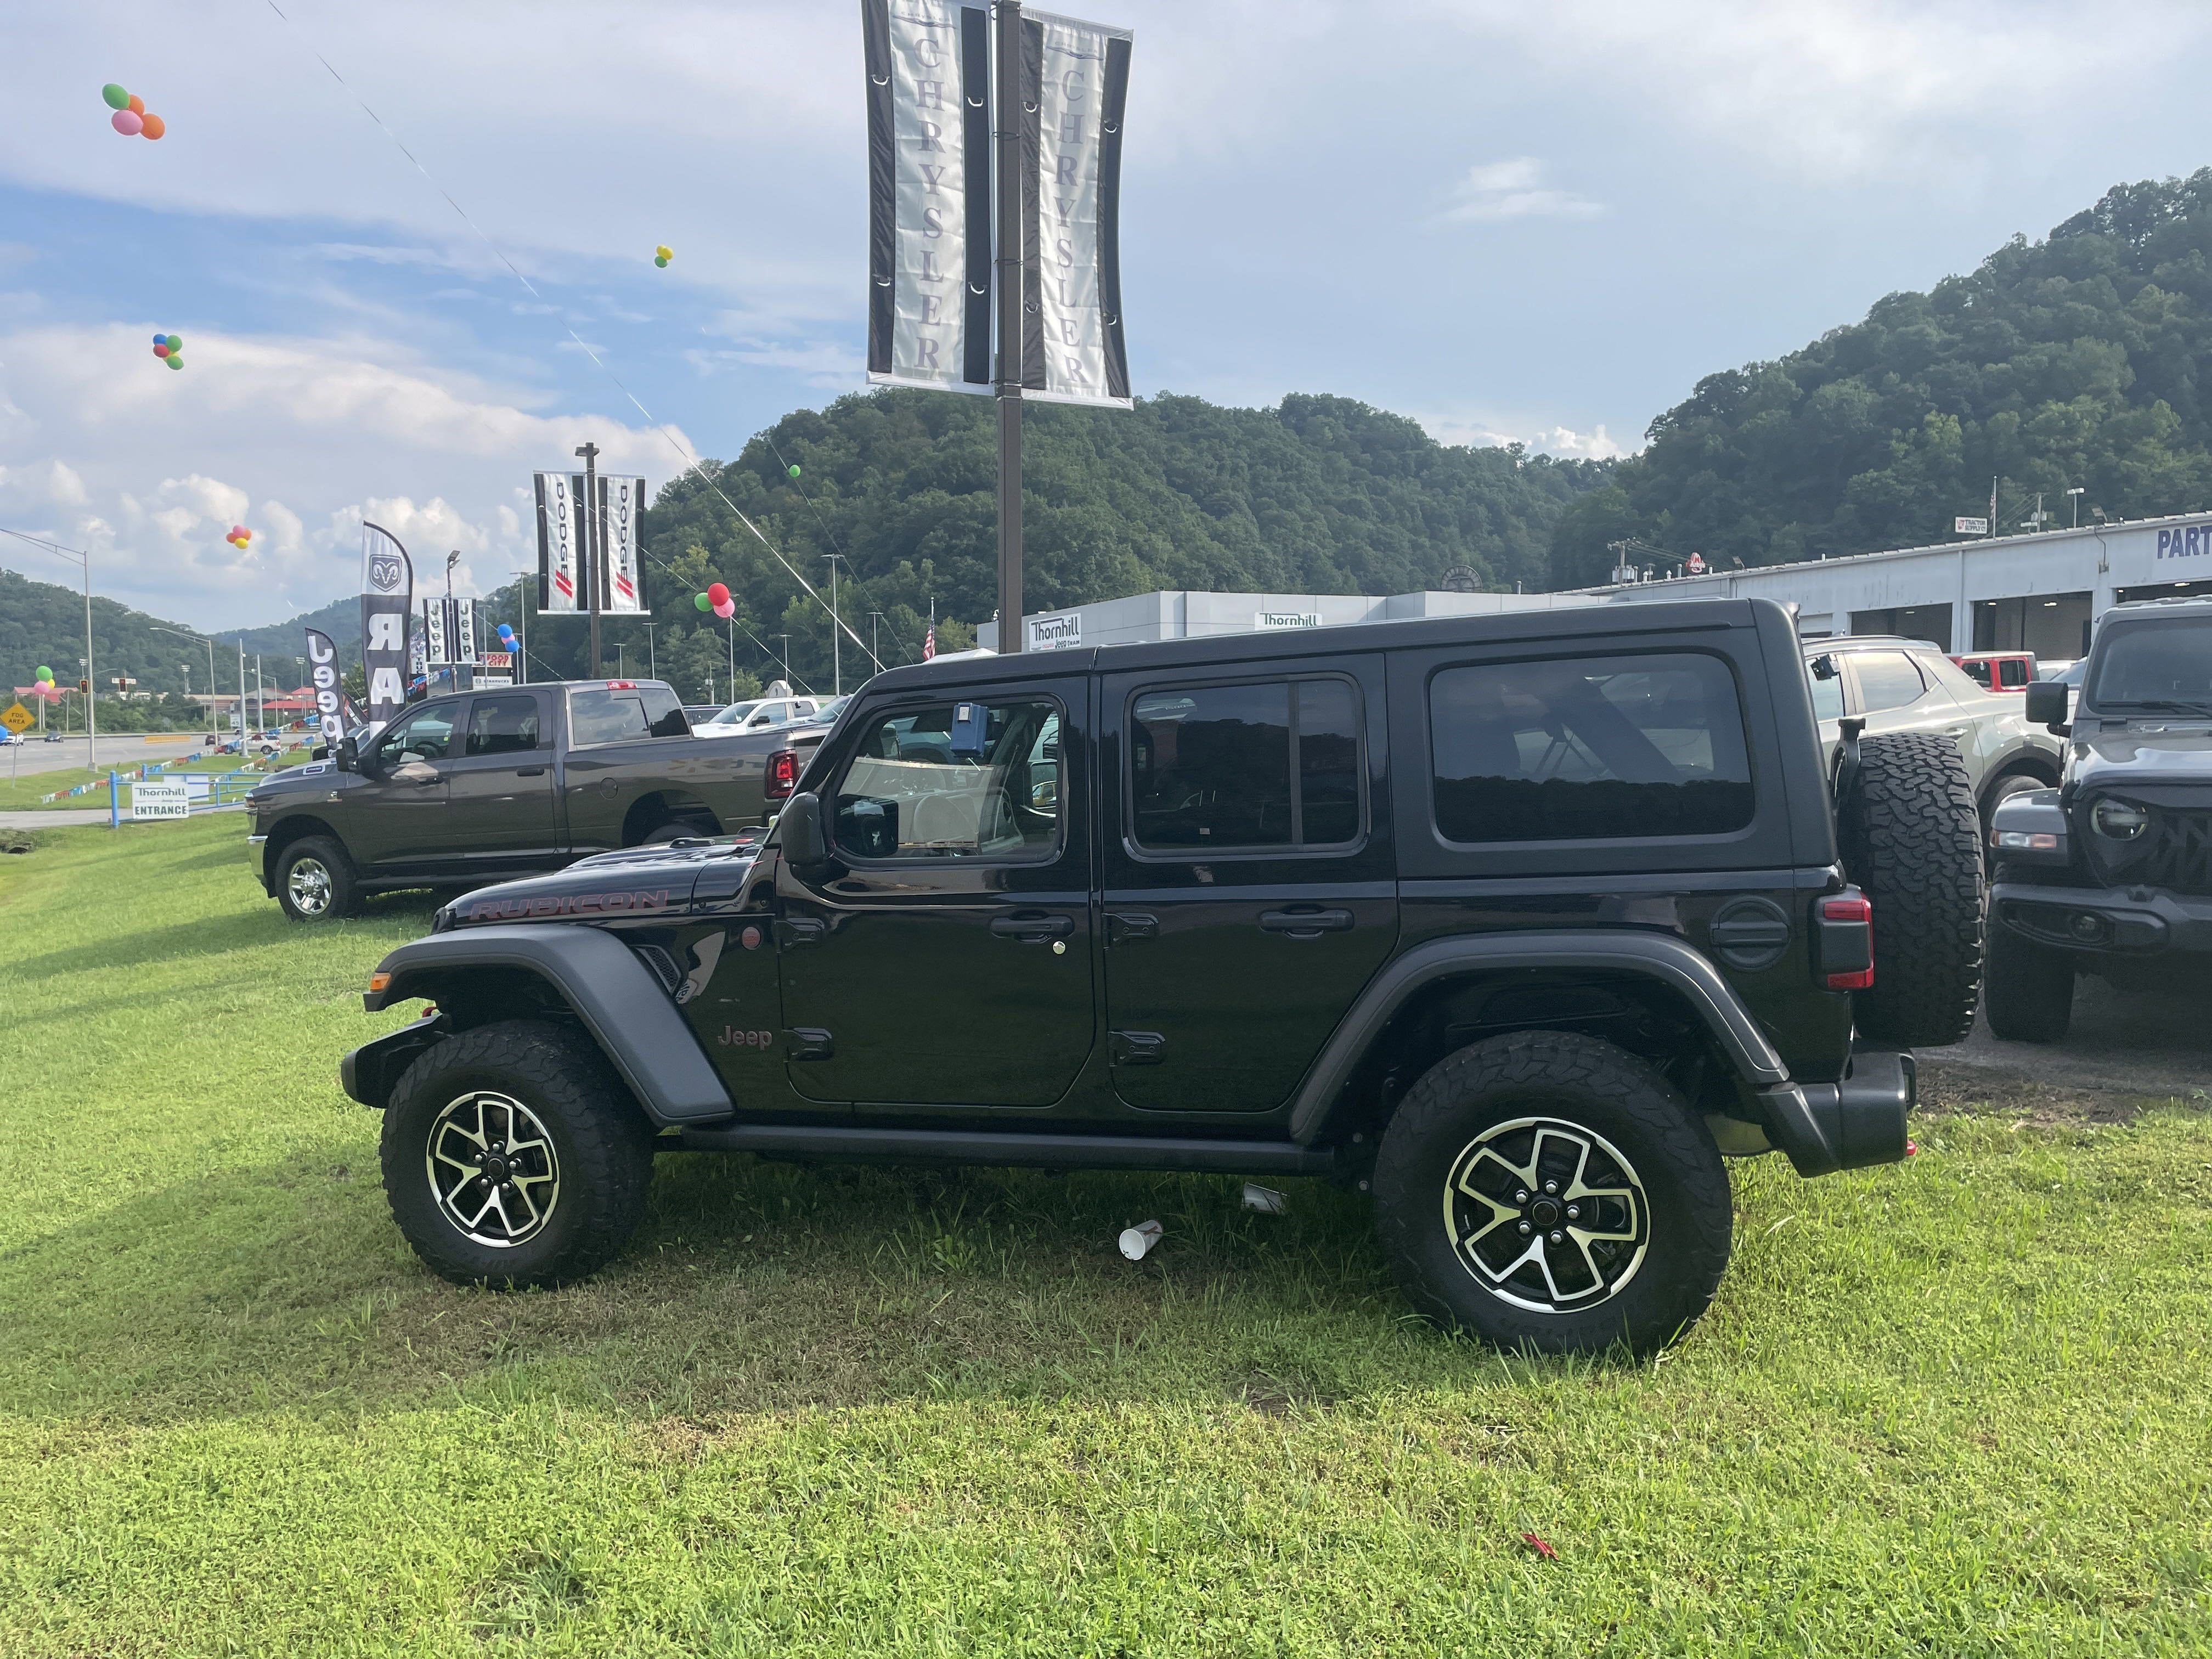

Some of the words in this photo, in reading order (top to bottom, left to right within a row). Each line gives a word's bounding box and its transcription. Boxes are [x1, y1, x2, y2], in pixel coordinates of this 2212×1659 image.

[913, 38, 946, 369] CHRYSLER
[1053, 70, 1089, 383] CHRYSLER
[556, 482, 568, 581] DODGE
[2158, 525, 2212, 559] PART
[431, 605, 441, 656] Jeep
[460, 604, 472, 656] Jeep
[1031, 617, 1079, 641] Thornhill
[1260, 613, 1317, 627] Thornhill
[1055, 640, 1066, 650] Jeep
[134, 787, 186, 796] Thornhill
[134, 806, 187, 815] ENTRANCE
[470, 890, 669, 921] RUBICON
[718, 1025, 772, 1051] Jeep
